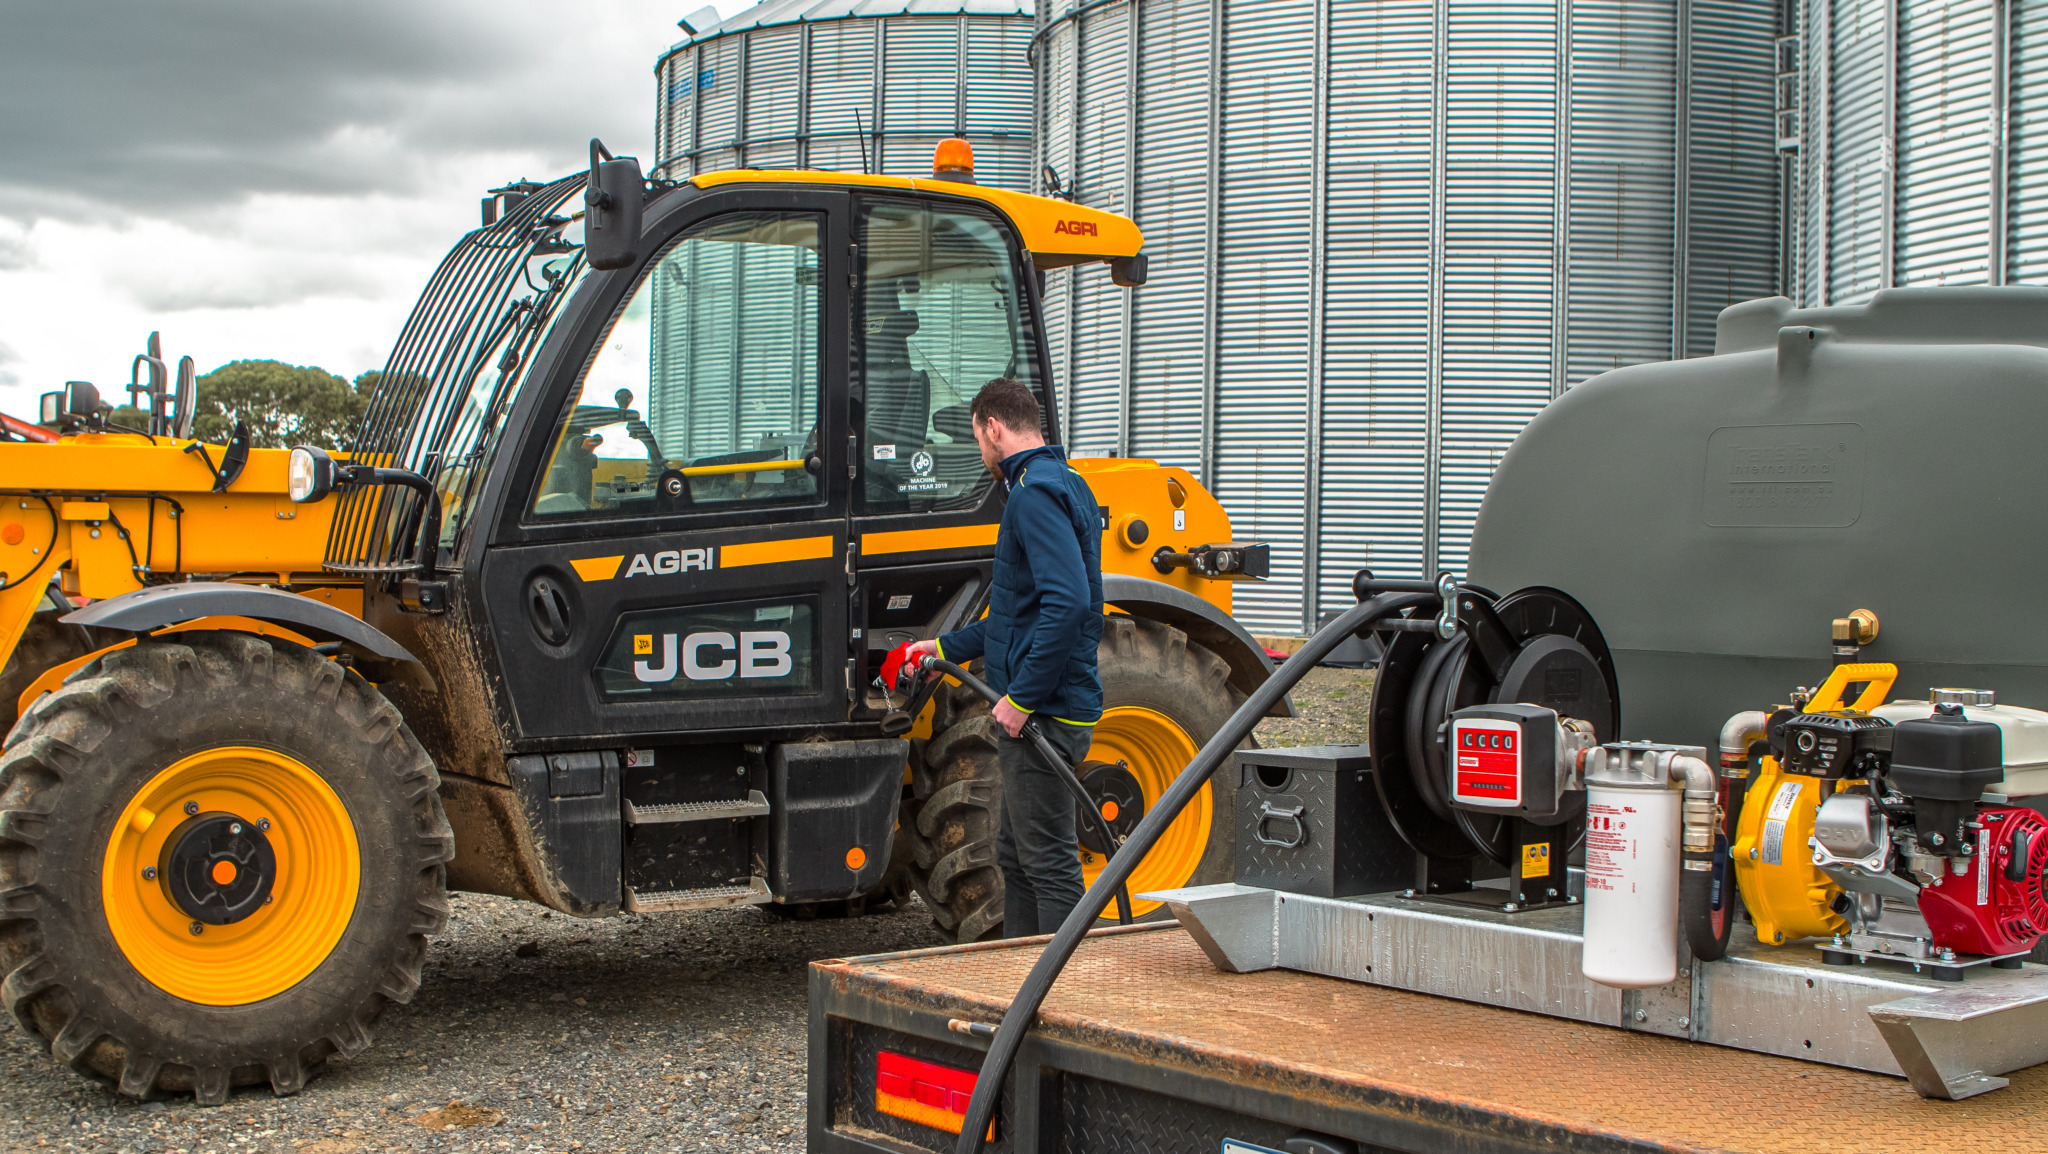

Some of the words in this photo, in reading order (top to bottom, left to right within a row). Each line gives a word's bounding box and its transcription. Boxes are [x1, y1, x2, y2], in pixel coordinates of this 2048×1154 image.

[1054, 219, 1098, 237] AGRI
[1728, 462, 1836, 475] International
[625, 547, 714, 578] AGRI
[637, 638, 650, 649] JCB
[633, 630, 792, 683] JCB
